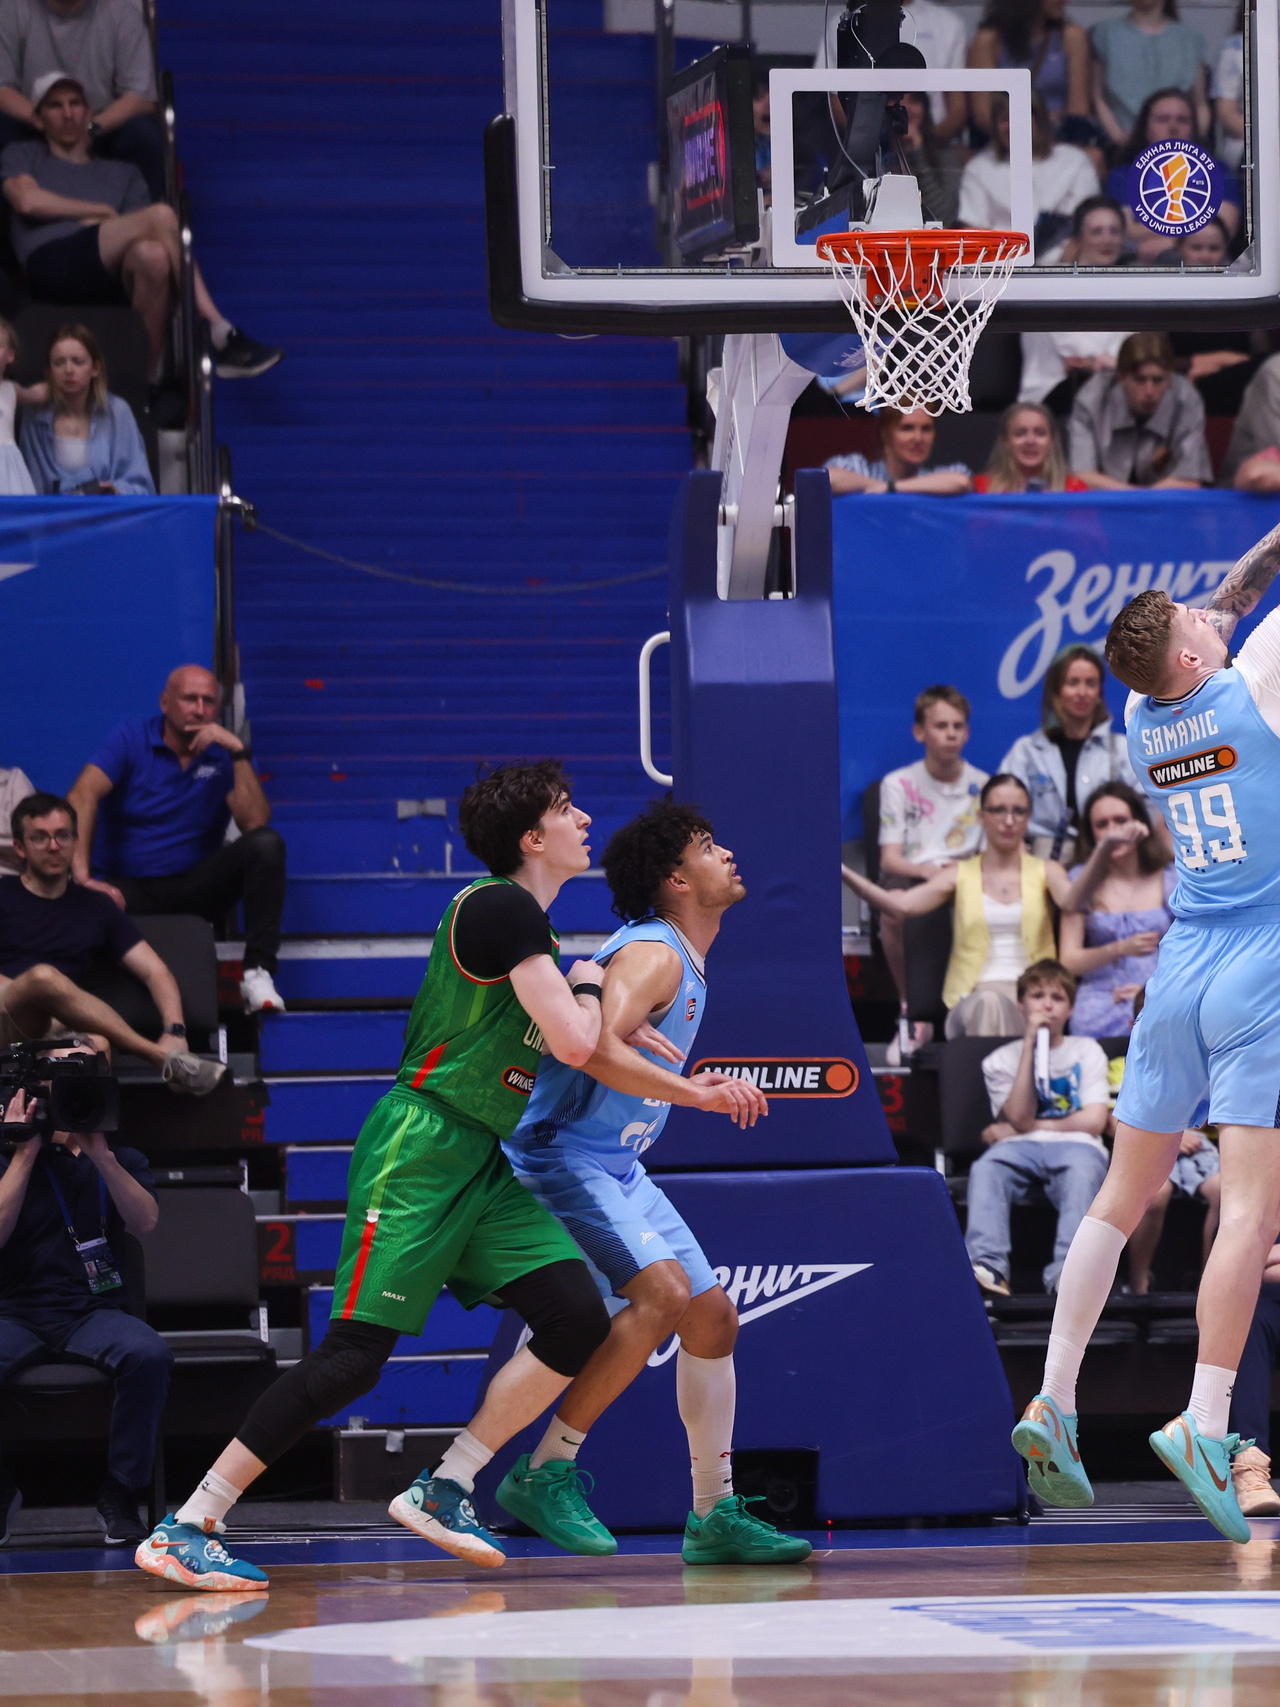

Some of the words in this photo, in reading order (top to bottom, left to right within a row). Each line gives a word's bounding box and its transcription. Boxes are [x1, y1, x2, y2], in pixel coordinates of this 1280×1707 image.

[1135, 142, 1172, 170] ЕДИНАЯ
[1173, 142, 1199, 157] ЛИГА
[1199, 153, 1215, 171] ВТБ
[1135, 204, 1150, 220] VTB
[1148, 219, 1183, 235] UNITED
[1183, 205, 1216, 234] LEAGUE
[1141, 708, 1219, 756] SAMANIC
[1152, 753, 1217, 784] WINLINE
[1167, 782, 1248, 869] 99
[265, 1222, 292, 1262] 2
[381, 1290, 407, 1302] MAXX
